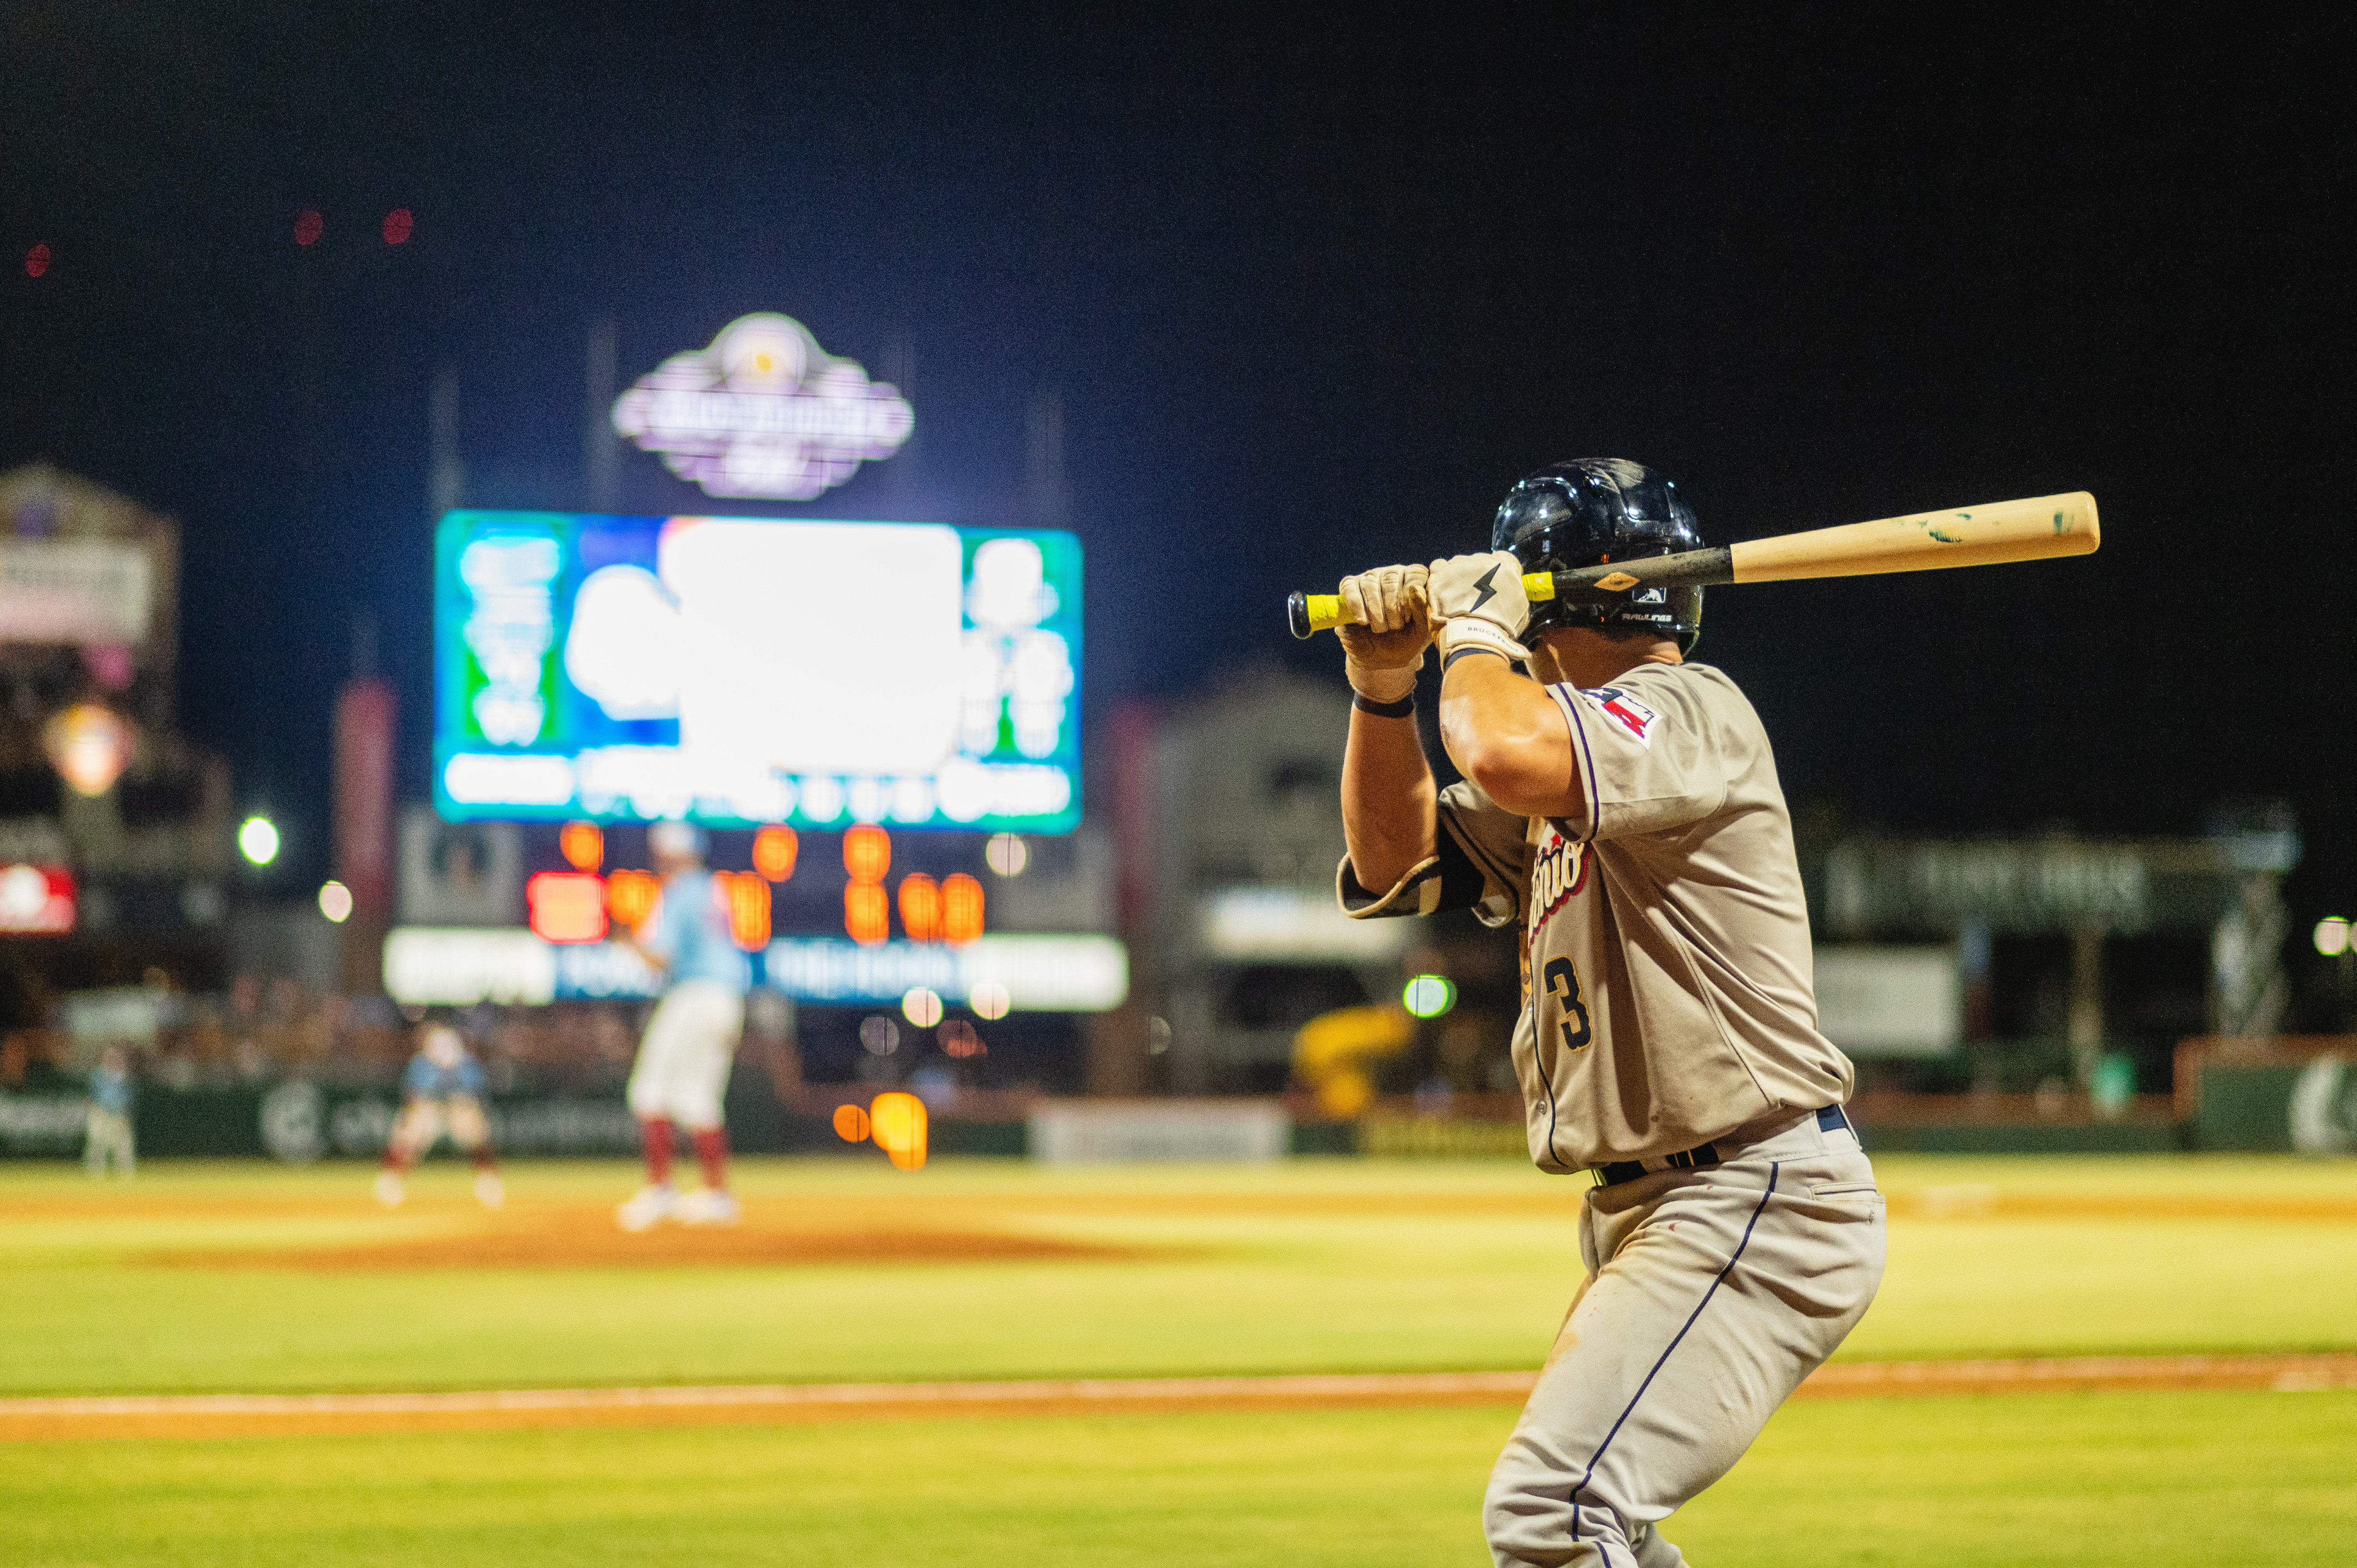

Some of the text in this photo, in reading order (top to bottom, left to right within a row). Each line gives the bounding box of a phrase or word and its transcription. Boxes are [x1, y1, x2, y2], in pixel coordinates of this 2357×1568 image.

[1621, 613, 1672, 622] RAWLINGS
[1467, 626, 1497, 637] BRUCE
[1544, 955, 1593, 1052] 3
